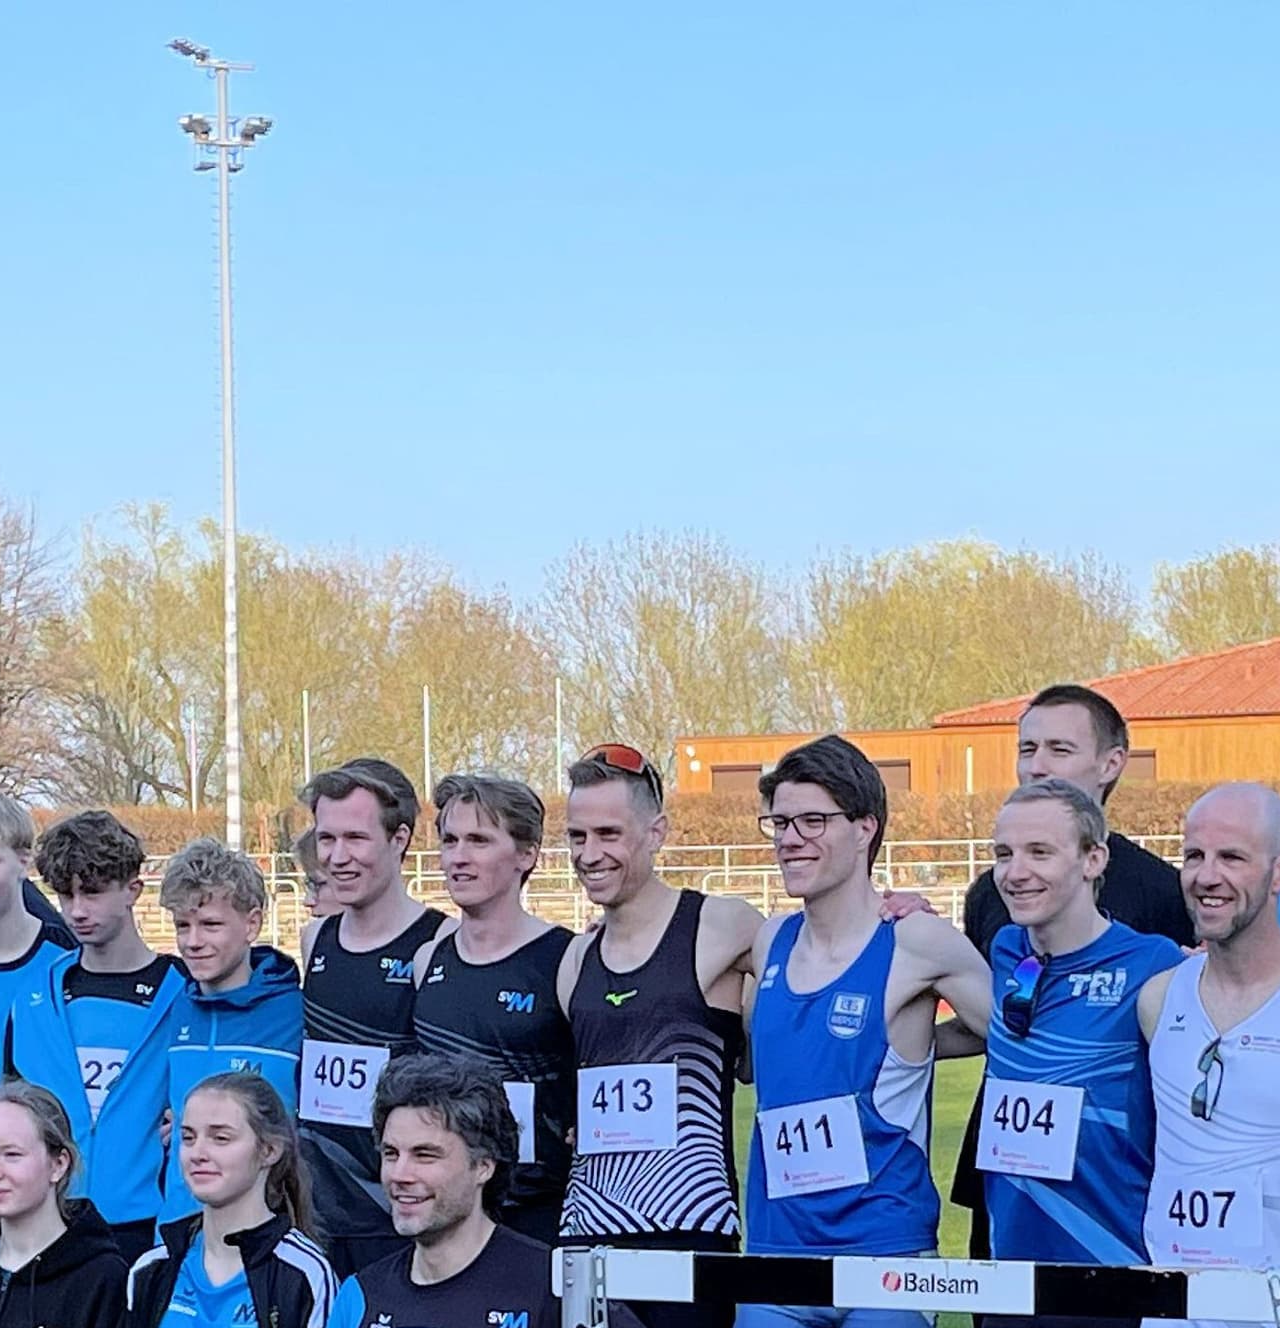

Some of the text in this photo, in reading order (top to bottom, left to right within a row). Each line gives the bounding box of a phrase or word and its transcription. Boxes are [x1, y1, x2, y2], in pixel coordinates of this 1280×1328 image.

[380, 957, 413, 978] SVM
[498, 991, 535, 1013] SVM
[314, 1054, 367, 1090] 405
[592, 1078, 654, 1113] 413
[993, 1094, 1055, 1136] 404
[776, 1113, 834, 1156] 411
[1168, 1189, 1236, 1228] 407
[903, 1271, 979, 1295] Balsam
